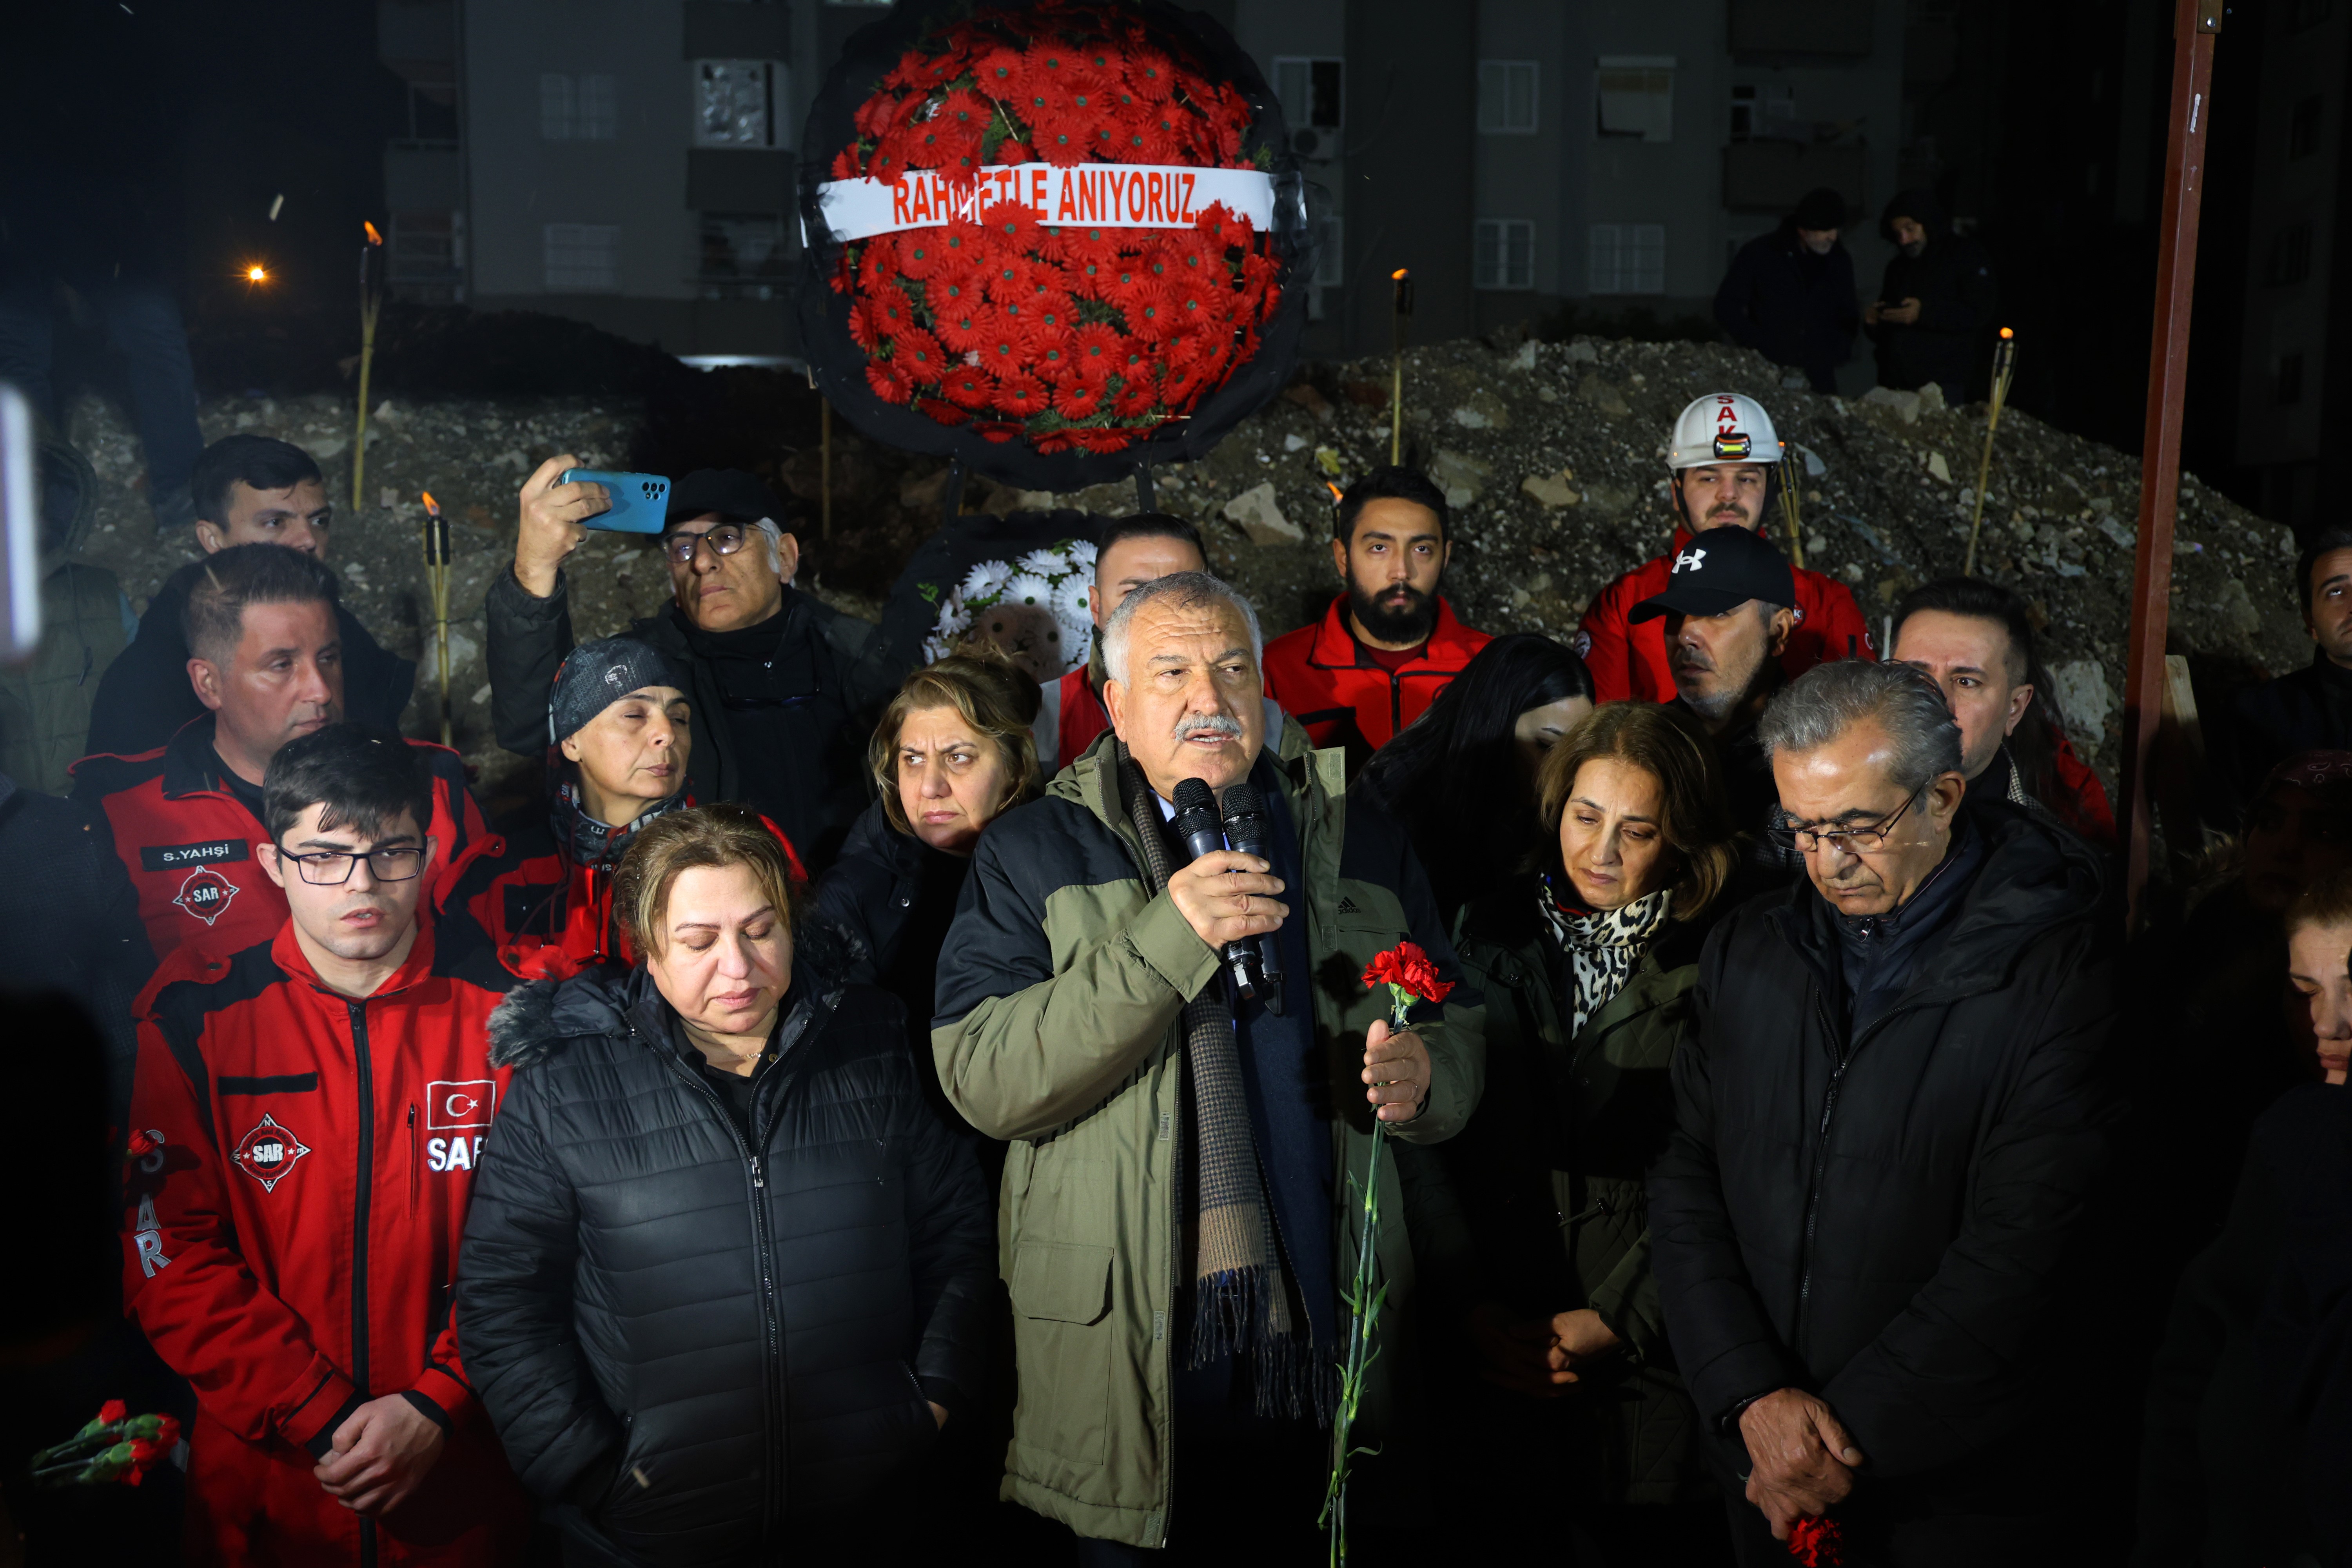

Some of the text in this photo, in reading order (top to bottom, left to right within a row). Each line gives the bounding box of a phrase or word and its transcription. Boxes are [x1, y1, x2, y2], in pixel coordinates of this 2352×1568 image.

[163, 844, 229, 861] S.YAHŞİ
[193, 887, 219, 902] SAR
[252, 1143, 283, 1163] SAR
